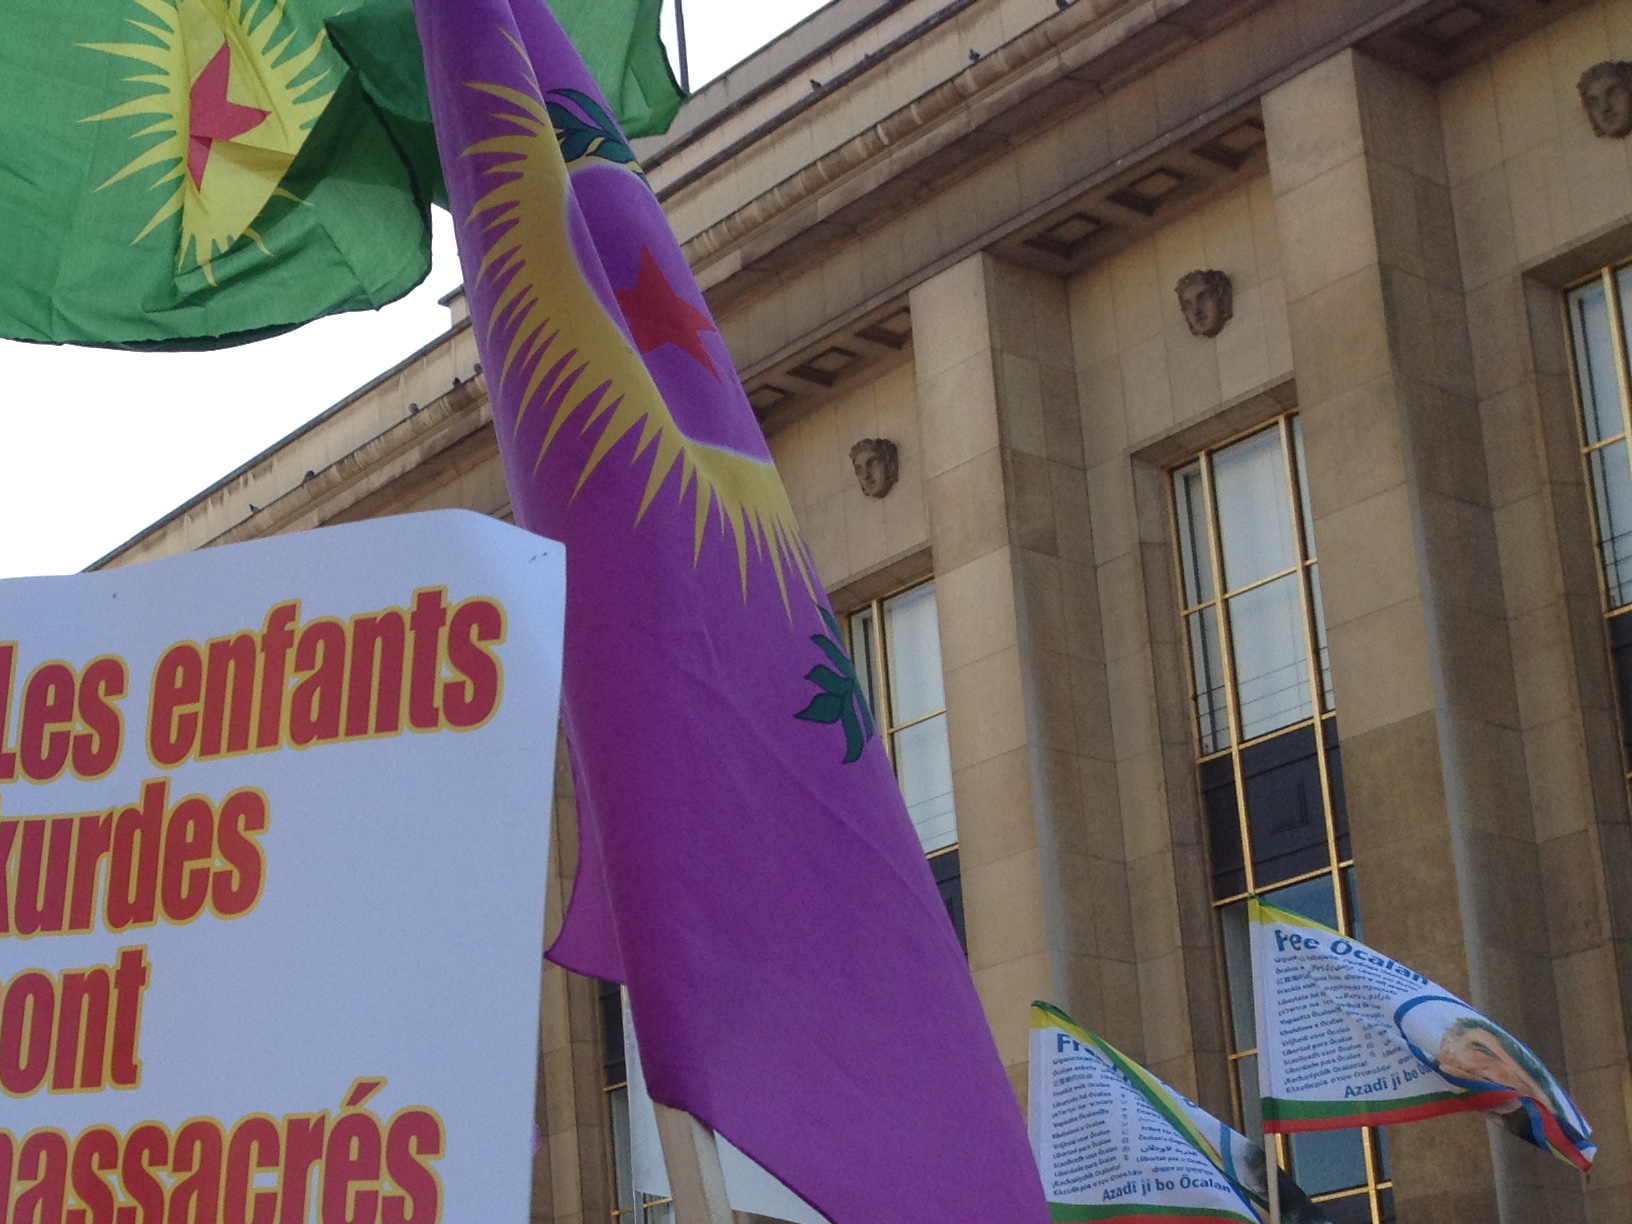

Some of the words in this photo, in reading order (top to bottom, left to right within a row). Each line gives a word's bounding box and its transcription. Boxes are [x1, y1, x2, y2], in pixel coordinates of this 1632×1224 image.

[145, 584, 507, 769] enfants
[1344, 1077, 1388, 1098] Azadî
[1390, 1073, 1401, 1090] ji
[1103, 1181, 1137, 1202] Azadî
[1141, 1179, 1151, 1196] ji
[1155, 1178, 1174, 1191] bo
[1180, 1174, 1231, 1193] Öcalan
